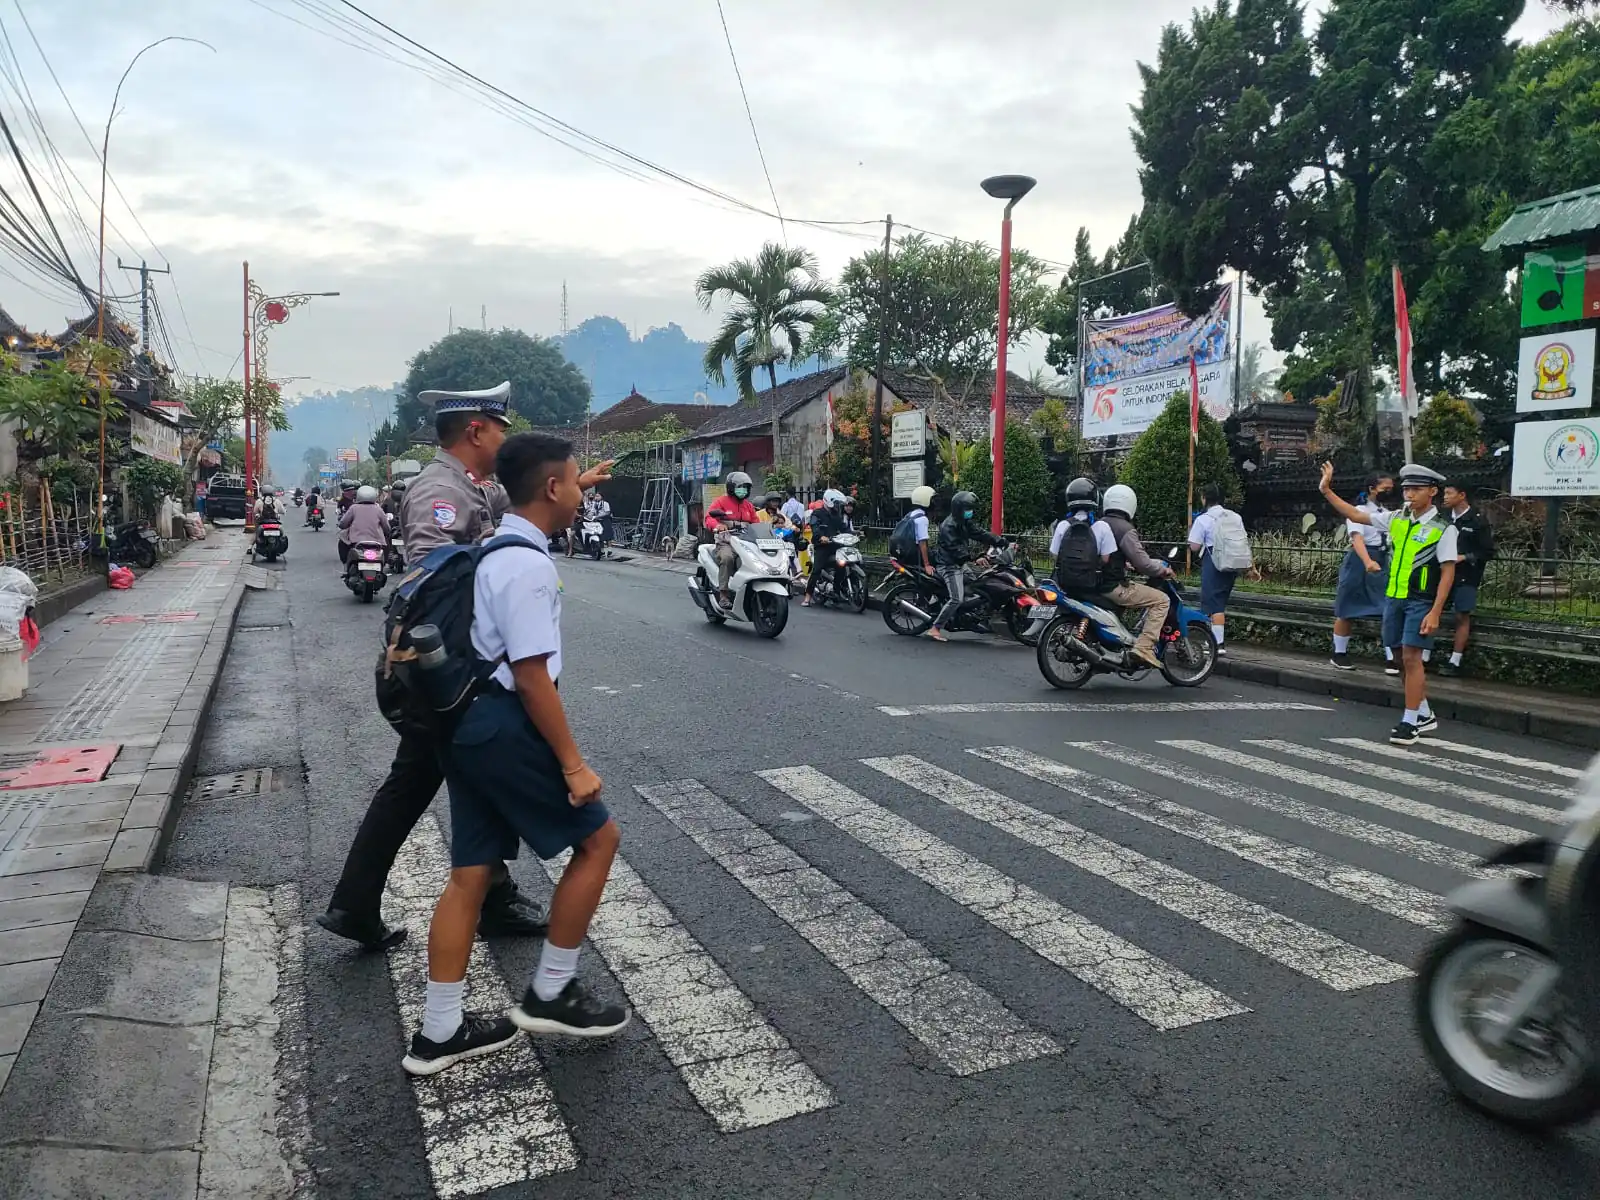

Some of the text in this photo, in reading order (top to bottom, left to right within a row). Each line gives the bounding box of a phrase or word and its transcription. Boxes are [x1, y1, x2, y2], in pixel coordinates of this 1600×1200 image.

[1122, 381, 1165, 397] GELORAKAN
[1166, 377, 1186, 389] BELA
[1121, 396, 1144, 408] UNTUK
